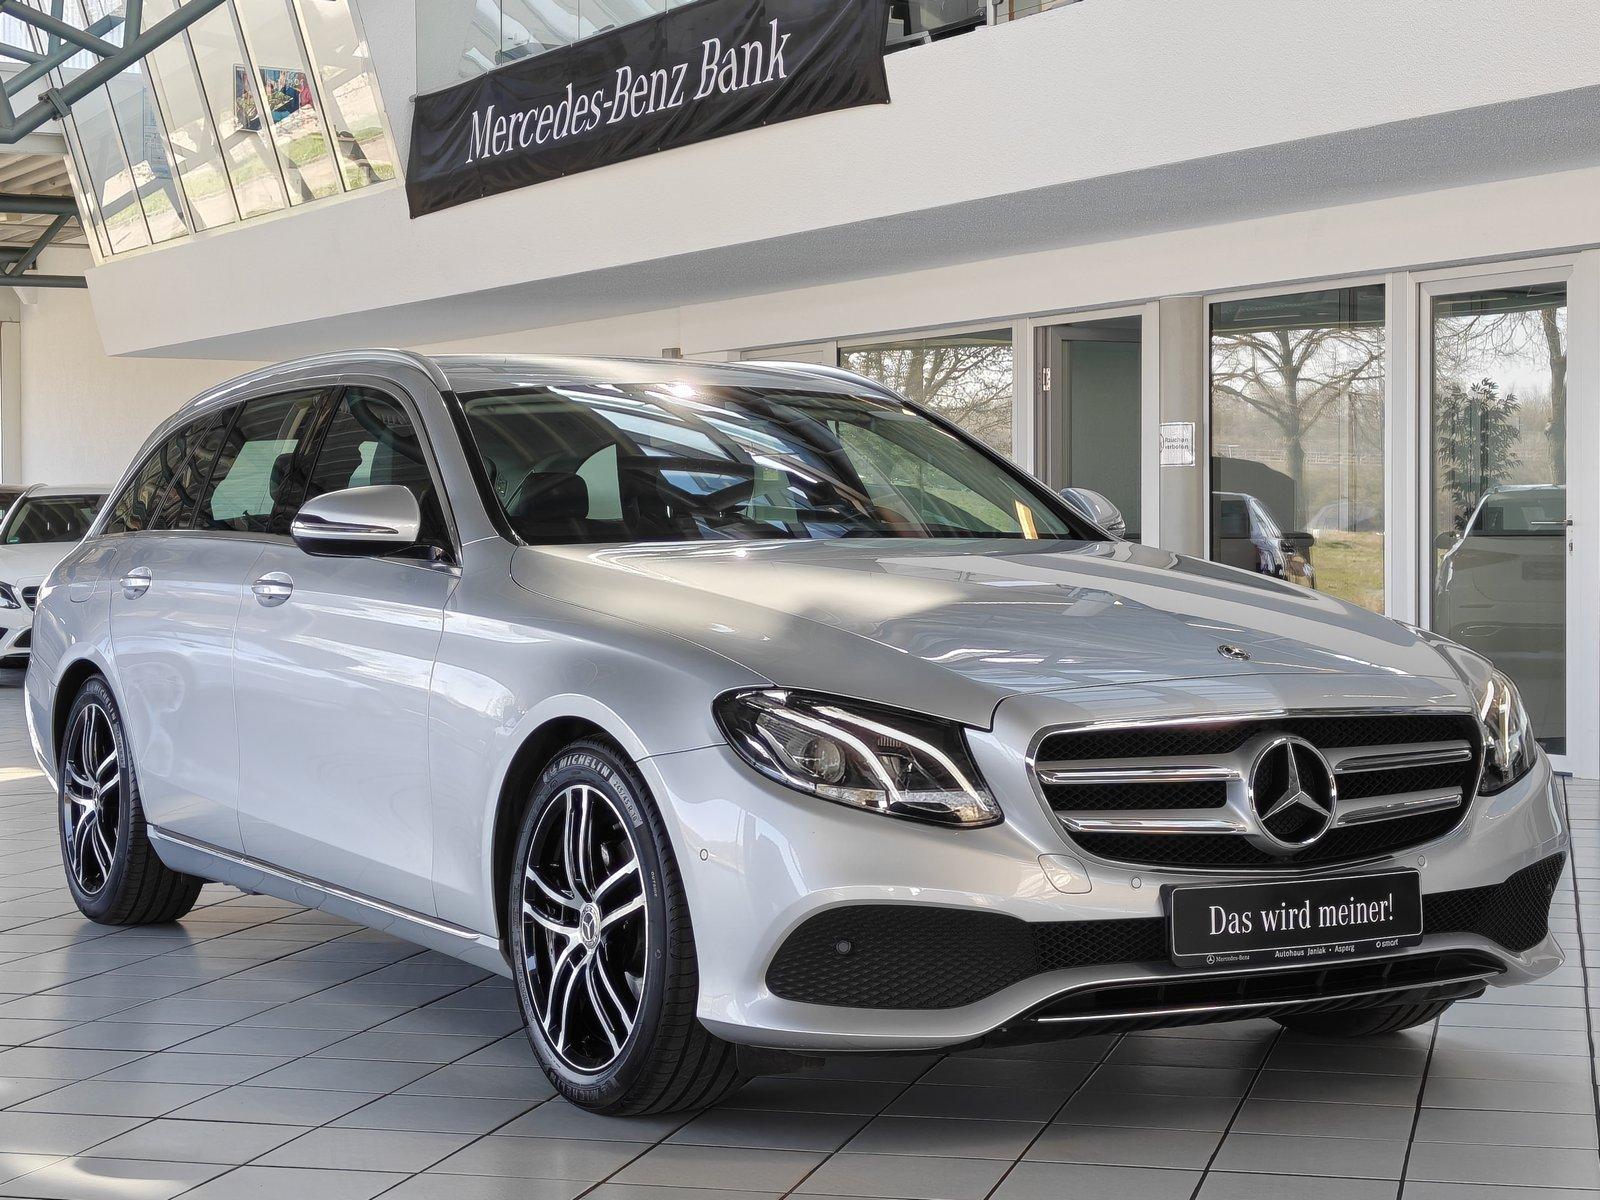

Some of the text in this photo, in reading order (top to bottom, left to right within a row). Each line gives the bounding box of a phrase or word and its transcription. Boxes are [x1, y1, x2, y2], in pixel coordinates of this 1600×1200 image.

[465, 18, 791, 164] Mercedes-Benz Bank
[559, 754, 611, 778] MICHELIN
[1209, 892, 1394, 935] Das wird meiner!
[1215, 954, 1250, 962] Mercedes-Benz
[1275, 949, 1305, 958] Autohaus
[1334, 945, 1355, 953] Asperg
